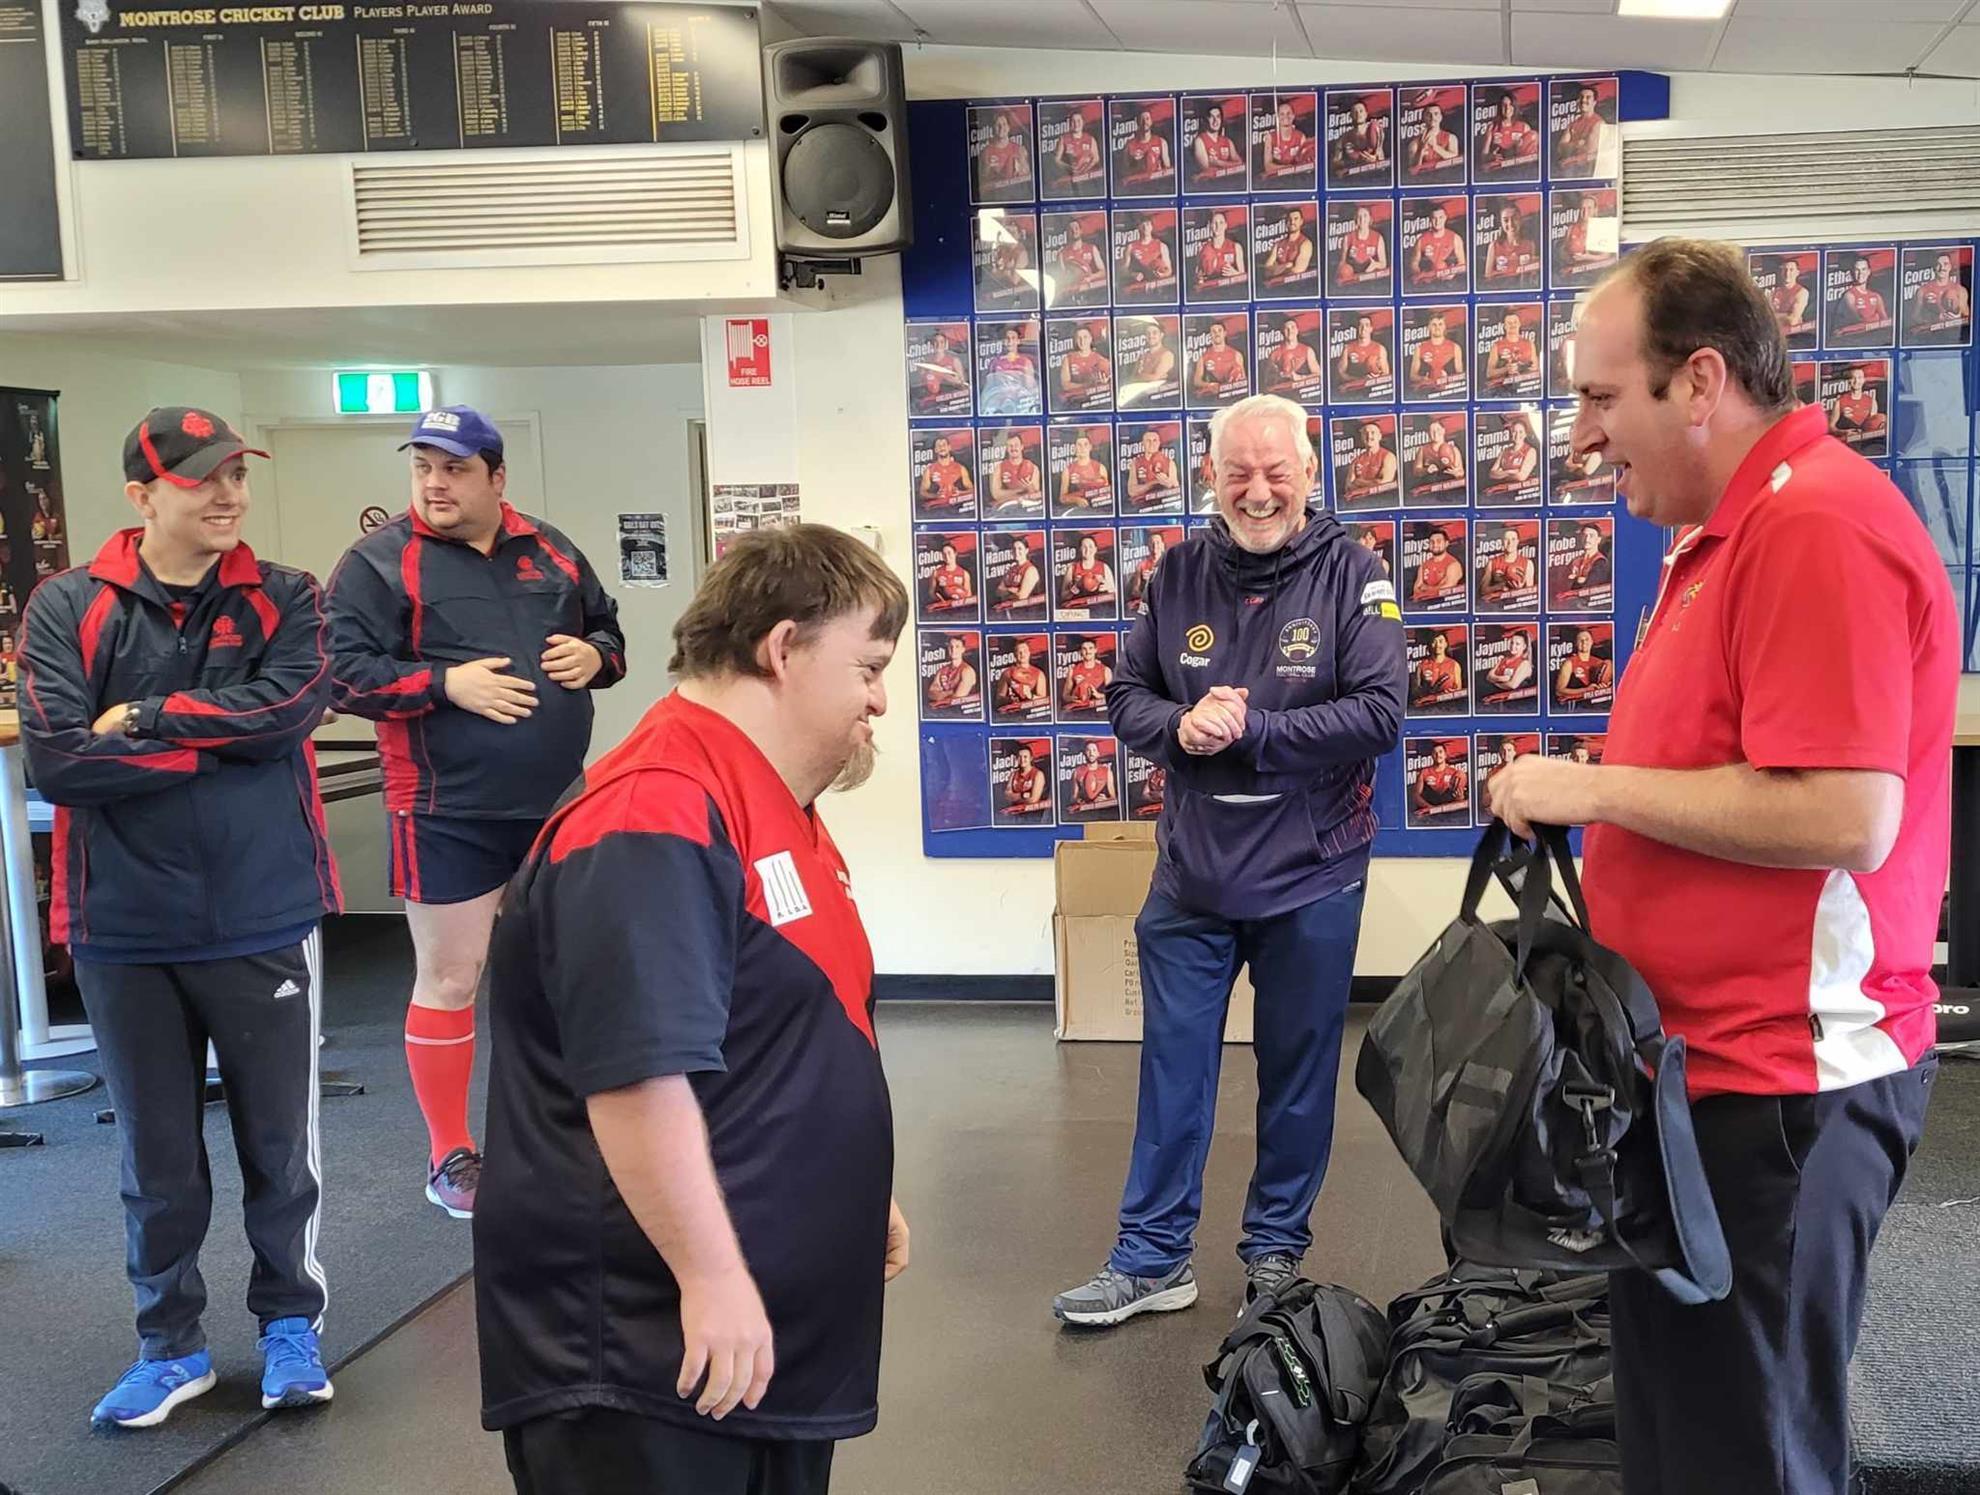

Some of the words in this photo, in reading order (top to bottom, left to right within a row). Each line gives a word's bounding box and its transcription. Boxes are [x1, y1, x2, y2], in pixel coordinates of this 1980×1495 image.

[120, 9, 216, 27] MONTROSE
[220, 6, 295, 23] CRICKET
[299, 4, 344, 20] CLUB
[1477, 214, 1495, 231] Jet
[1552, 208, 1580, 225] Holly
[1115, 229, 1140, 246] Ryan
[1331, 326, 1357, 343] Josh
[1479, 322, 1505, 339] Jack
[1118, 334, 1147, 351] Isaac
[740, 367, 757, 376] FIRE
[730, 376, 750, 386] HOSE
[751, 375, 769, 385] REEL
[1334, 436, 1354, 452] Ben
[1477, 429, 1510, 447] Emma
[915, 449, 934, 463] Ben
[982, 445, 1006, 460] Riley
[1404, 538, 1430, 553] Rhys
[1549, 536, 1576, 553] Kobe
[1055, 547, 1077, 562] Ellie
[1291, 626, 1310, 641] 100
[921, 648, 946, 664] Josh
[1551, 642, 1573, 657] Kyle
[1180, 653, 1211, 668] Cogar
[1276, 665, 1317, 674] MONTROSE
